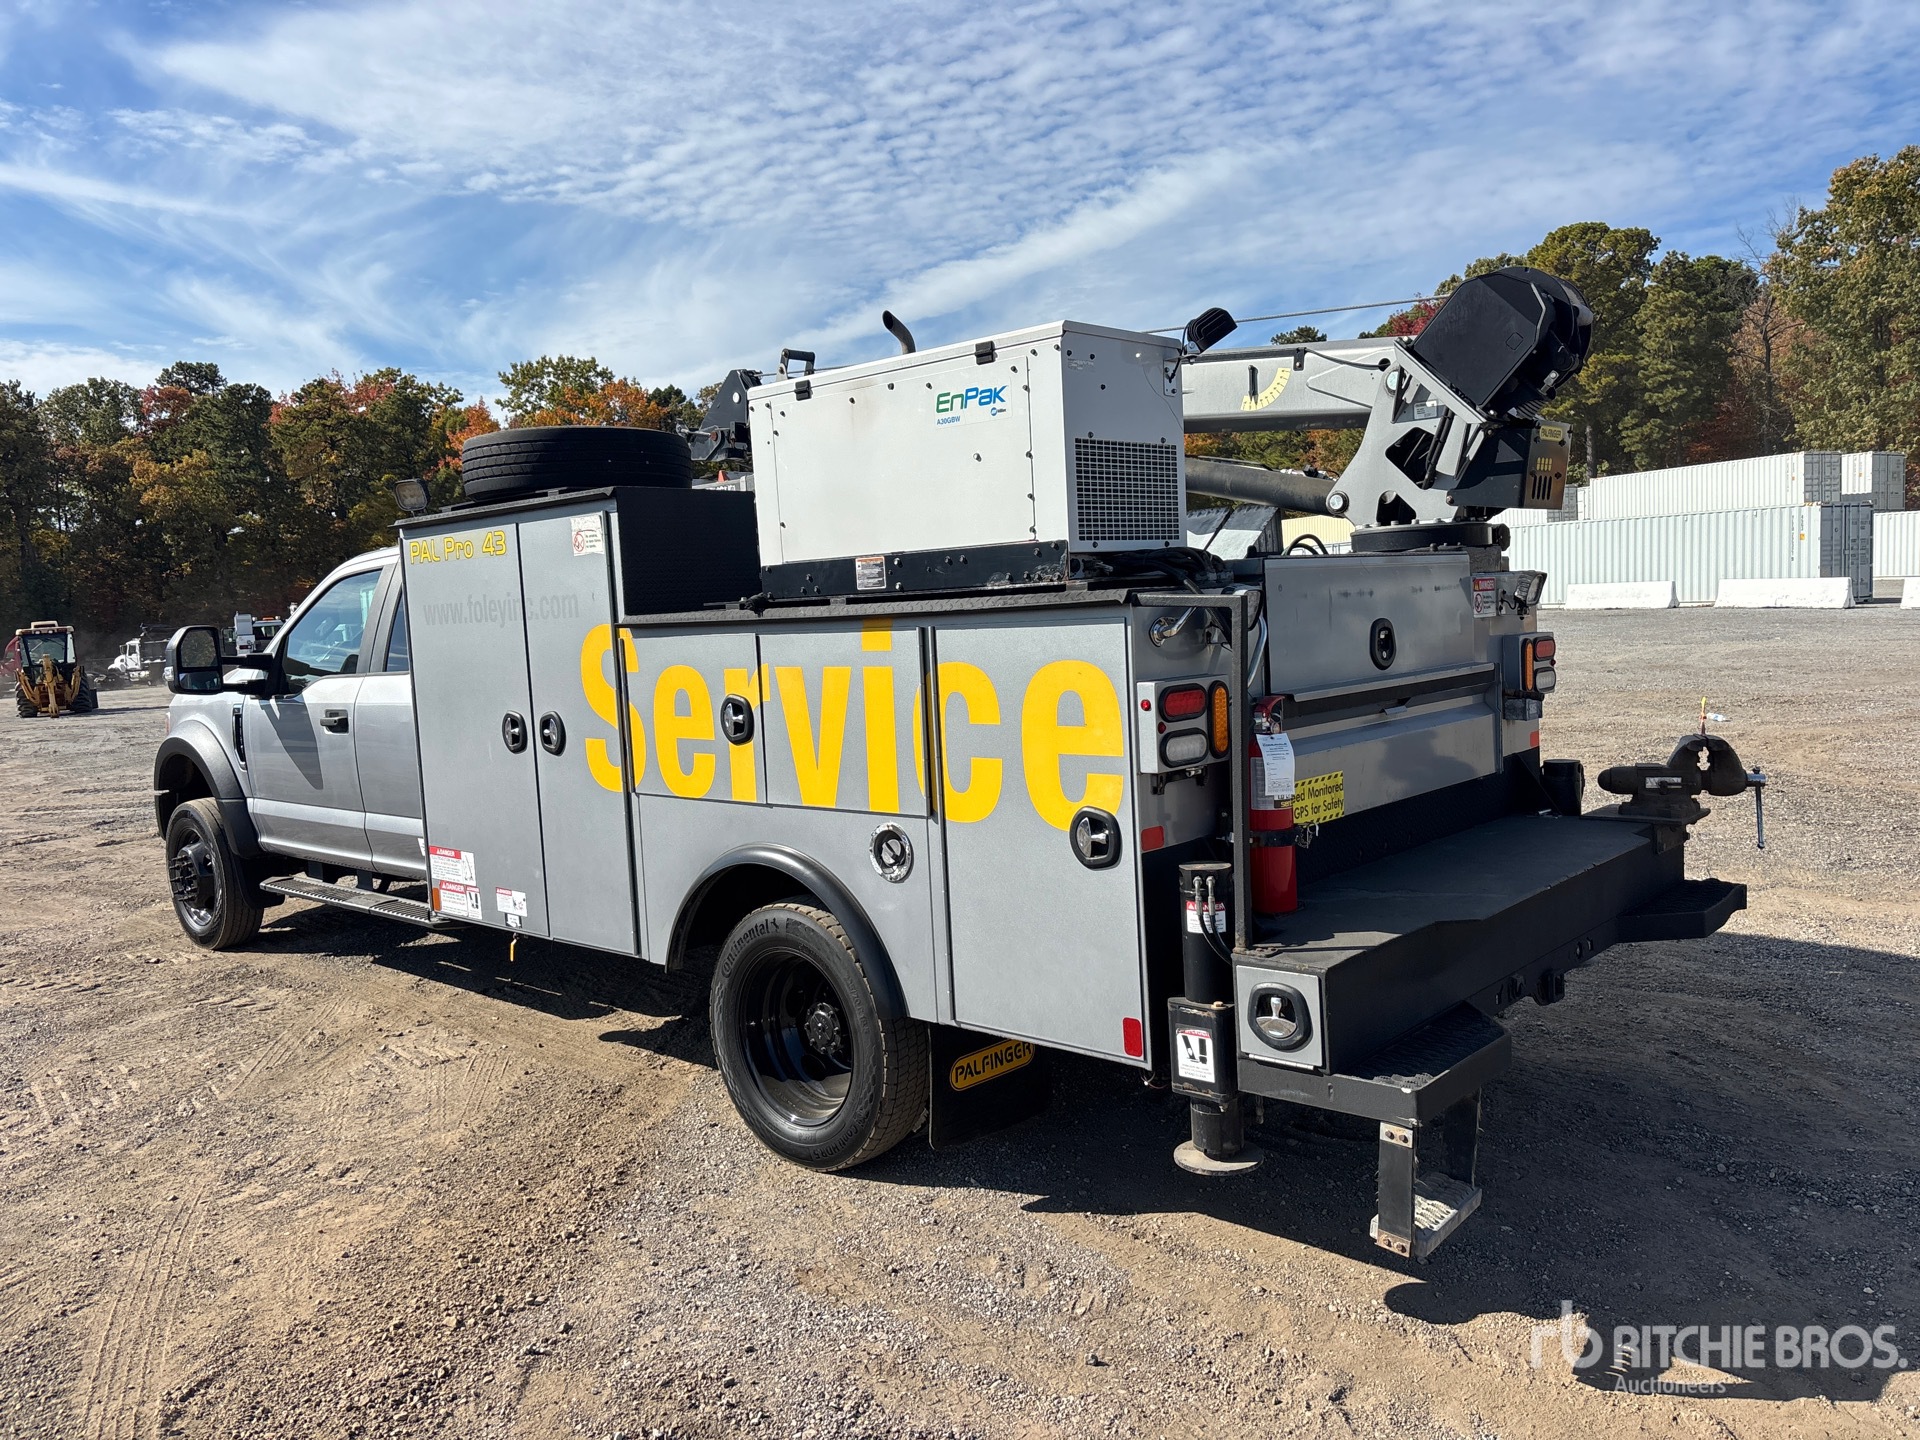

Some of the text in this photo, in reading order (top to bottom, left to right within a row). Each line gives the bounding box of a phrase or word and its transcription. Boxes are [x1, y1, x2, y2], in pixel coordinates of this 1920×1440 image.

[936, 385, 1008, 413] EnPak
[410, 530, 507, 564] PAL Pro 43
[423, 592, 580, 628] www.foleyinc.com
[580, 618, 1124, 831] Service
[1308, 778, 1344, 800] Monitored
[1294, 795, 1344, 819] GPS for Safety
[721, 918, 770, 978] Continental
[955, 1042, 1032, 1084] PALFINGER
